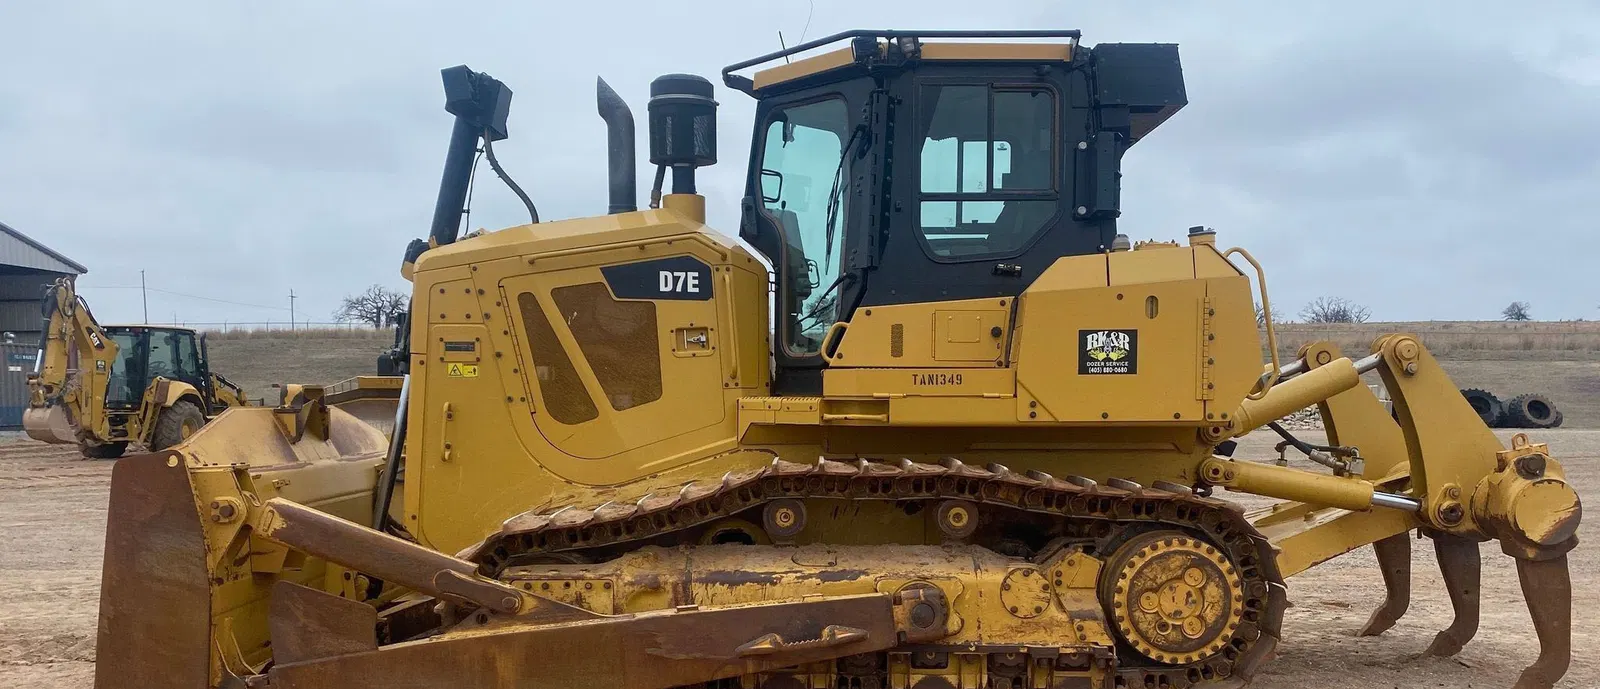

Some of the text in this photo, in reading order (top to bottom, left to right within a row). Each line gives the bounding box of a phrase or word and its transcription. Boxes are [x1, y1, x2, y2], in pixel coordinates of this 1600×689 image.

[660, 271, 699, 292] D7E
[90, 332, 100, 346] CAT
[1086, 331, 1130, 350] RK&R
